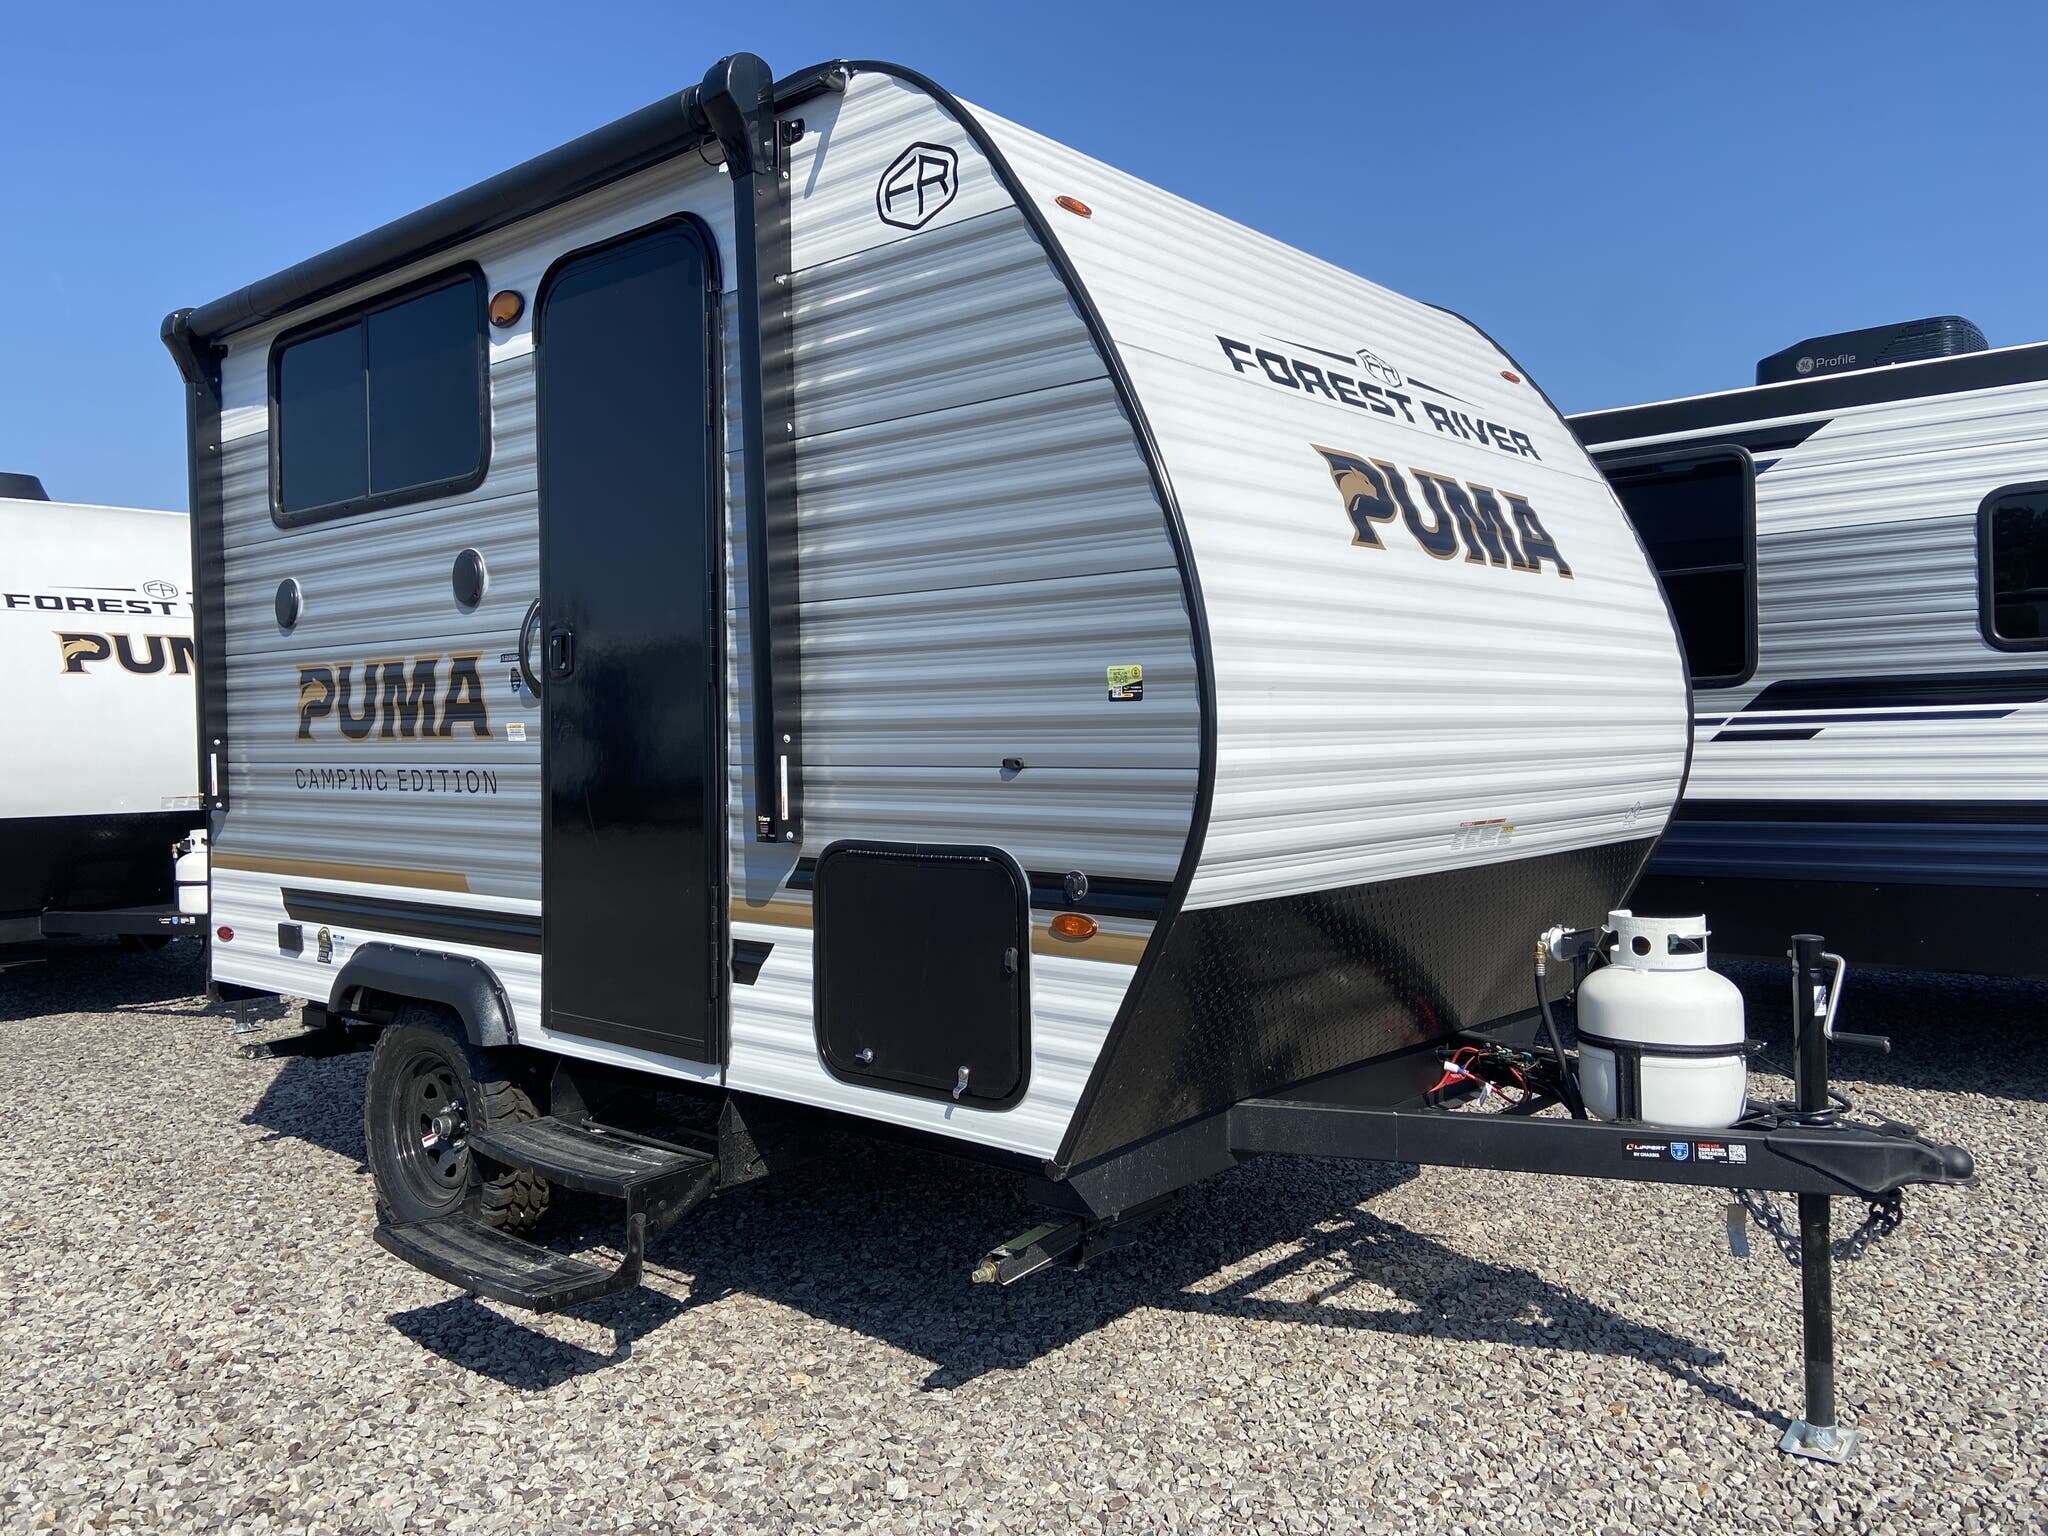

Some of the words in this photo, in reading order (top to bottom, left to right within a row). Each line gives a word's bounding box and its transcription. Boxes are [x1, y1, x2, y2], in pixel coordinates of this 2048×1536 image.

[1816, 353, 1857, 369] Profile
[1214, 334, 1416, 424] FOREST
[1420, 400, 1543, 462] RIVER
[1308, 443, 1575, 581] PUMA
[3, 593, 178, 616] FOREST
[296, 650, 495, 744] PUMA
[294, 768, 388, 792] CAMPING
[396, 769, 498, 795] EDITION
